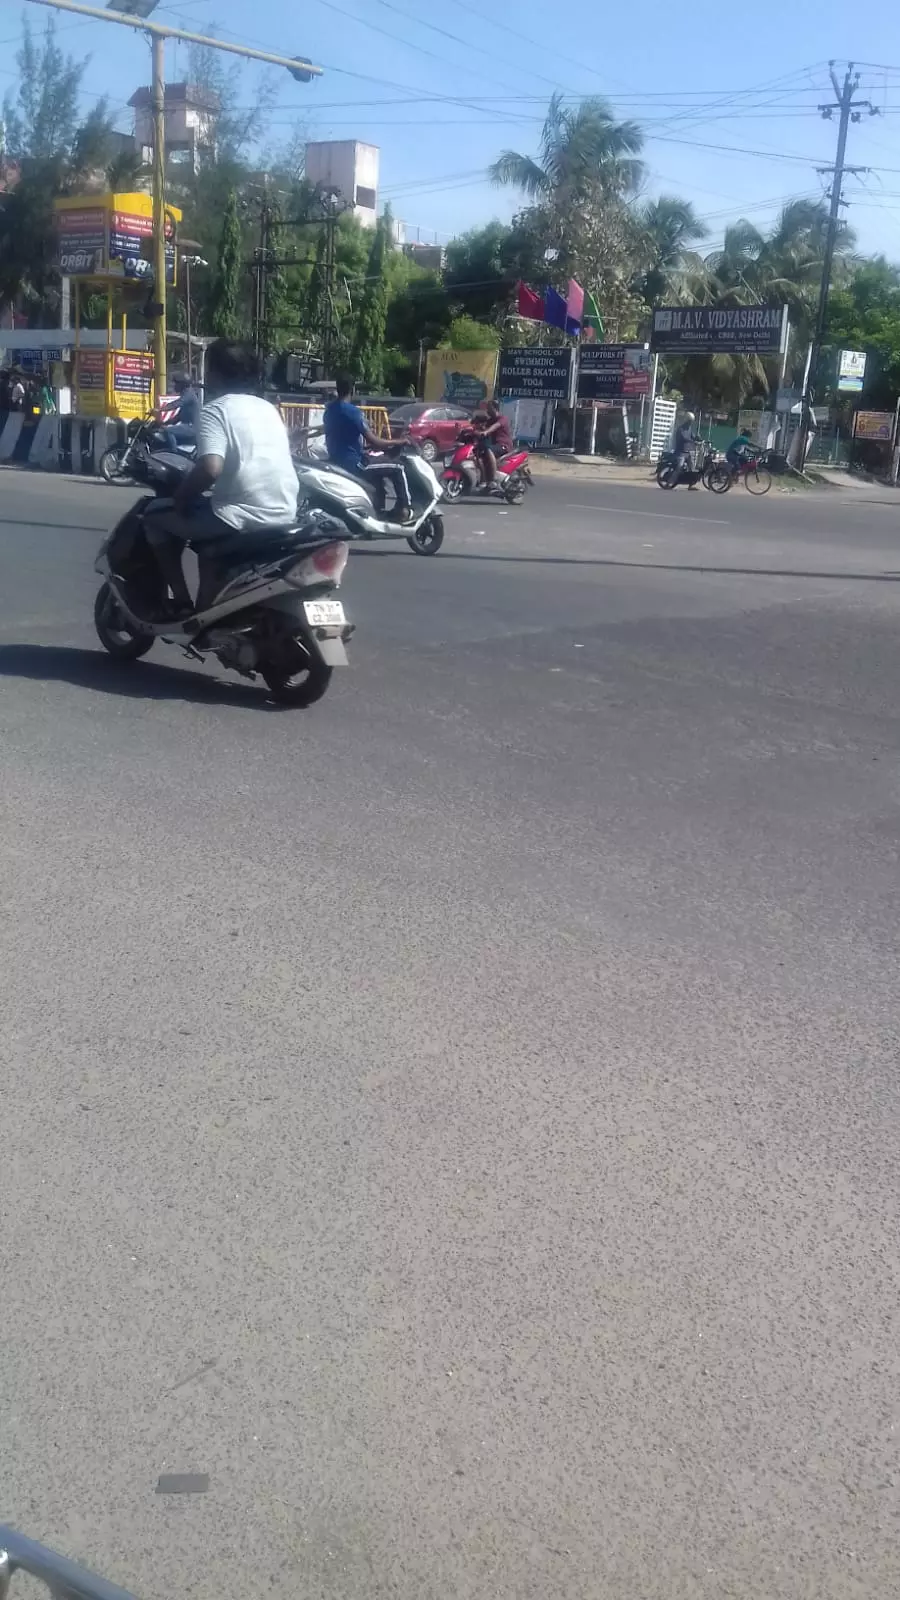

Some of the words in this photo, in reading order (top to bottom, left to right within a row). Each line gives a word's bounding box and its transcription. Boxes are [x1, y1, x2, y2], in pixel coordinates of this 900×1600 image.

[60, 253, 94, 269] ORBIT
[671, 311, 704, 329] M.A.V.
[708, 309, 781, 329] VIDYASHRAM
[523, 348, 552, 356] SCHOOL
[514, 357, 555, 366] SWIMMING
[502, 367, 531, 376] ROLLER
[532, 367, 567, 377] SKATING
[522, 377, 543, 387] YOGA
[501, 387, 532, 396] FITNESS
[533, 388, 565, 398] CENTRE
